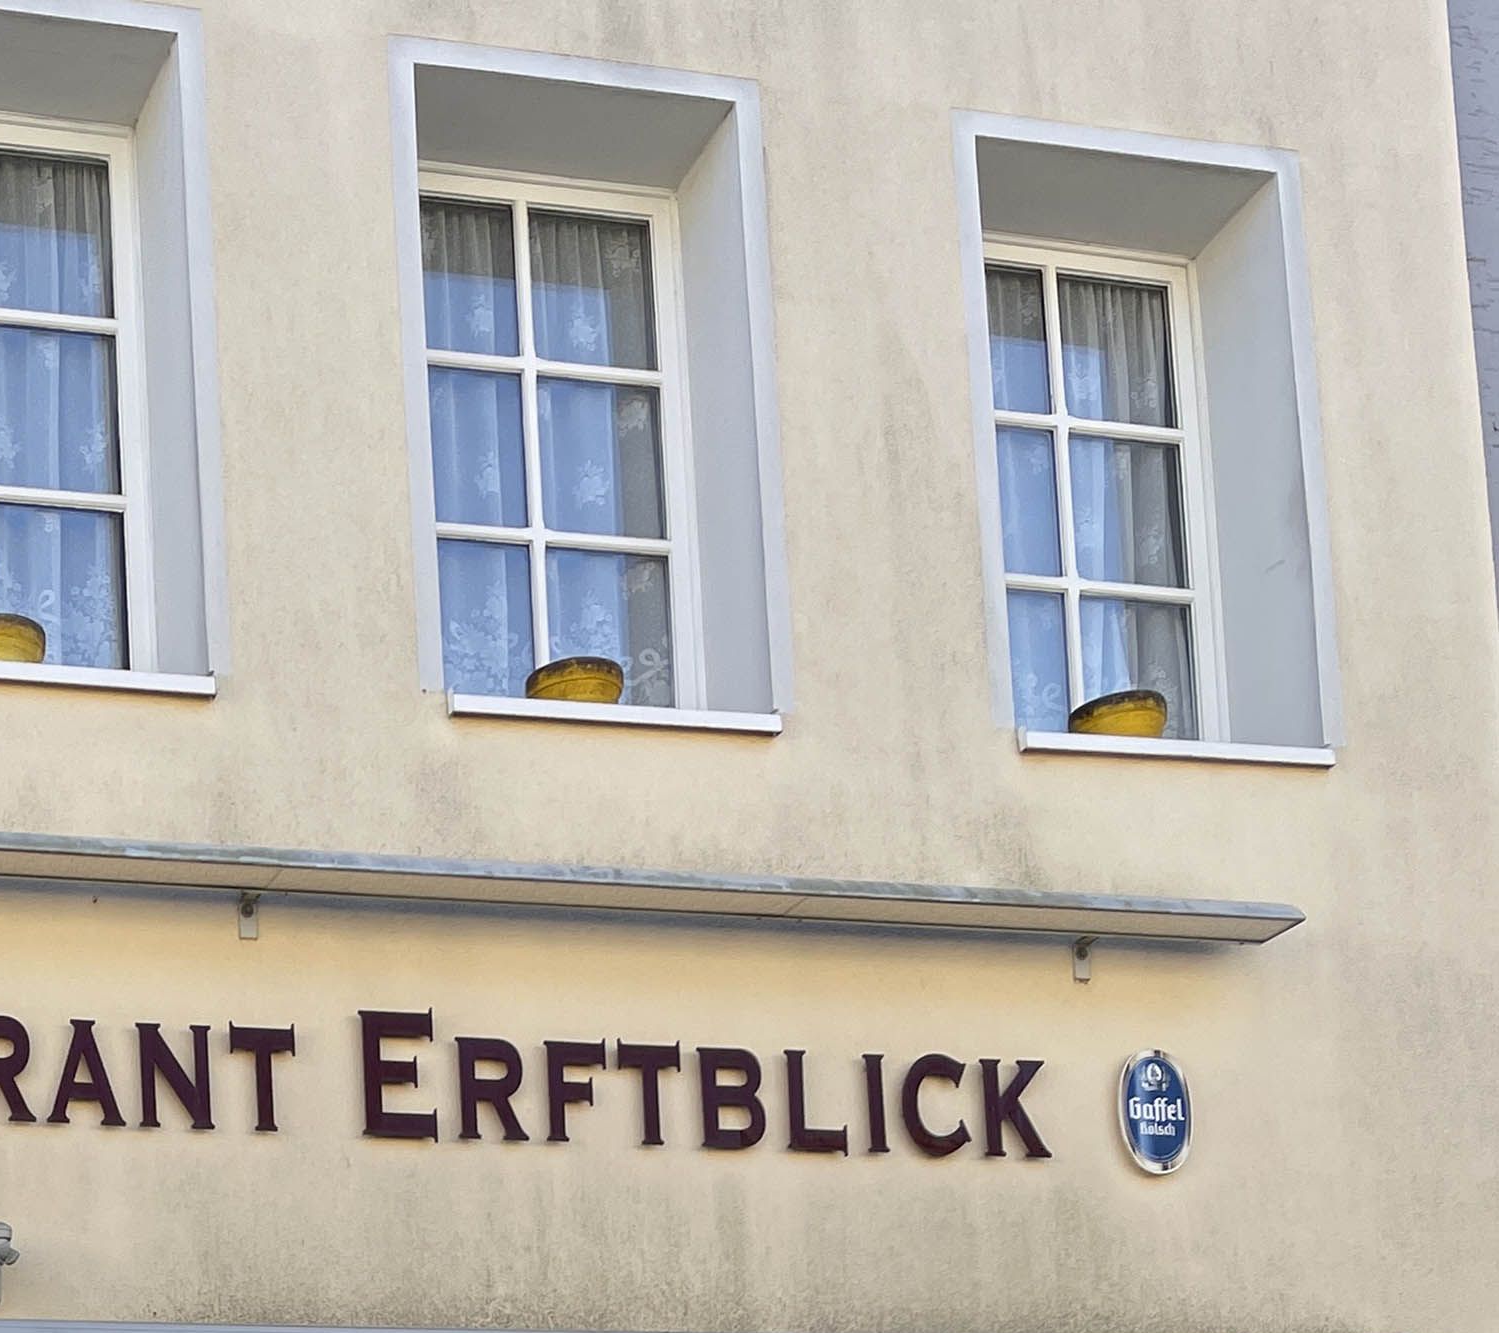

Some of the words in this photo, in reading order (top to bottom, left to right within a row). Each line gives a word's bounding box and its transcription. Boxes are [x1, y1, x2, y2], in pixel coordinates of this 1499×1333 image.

[357, 1007, 1053, 1160] ERFTBLICK
[1128, 1097, 1185, 1122] Gaffel
[1140, 1121, 1176, 1137] Kölsch
